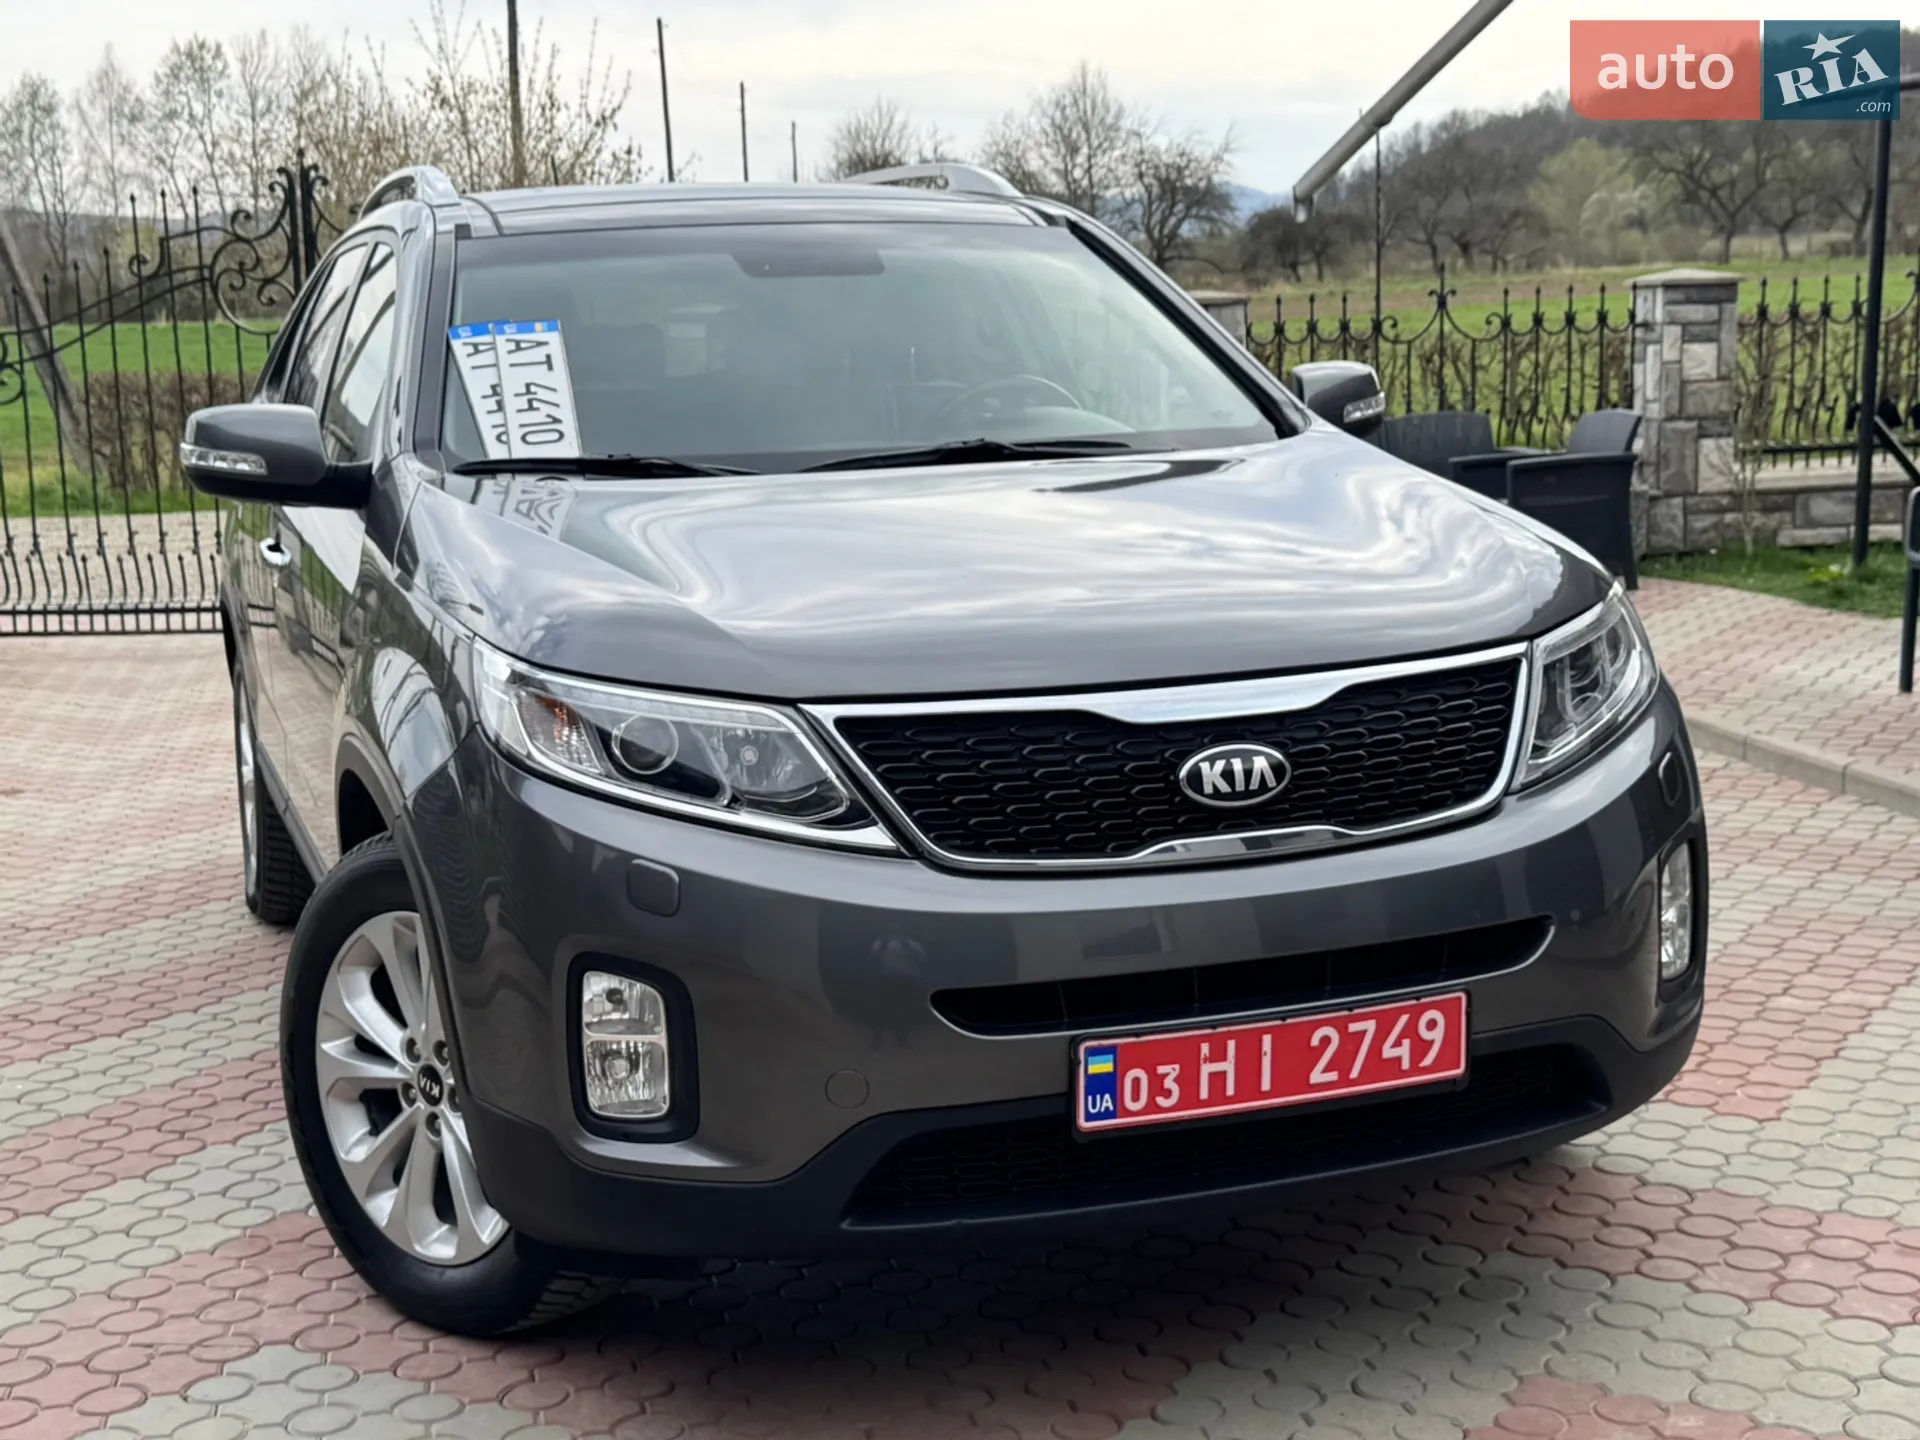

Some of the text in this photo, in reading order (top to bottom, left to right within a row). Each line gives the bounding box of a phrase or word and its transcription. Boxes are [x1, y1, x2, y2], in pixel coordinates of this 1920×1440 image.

[505, 338, 554, 371] AT
[513, 382, 565, 445] 4410
[1198, 755, 1277, 794] KIA
[1087, 1009, 1445, 1114] UA 03 HI 2749
